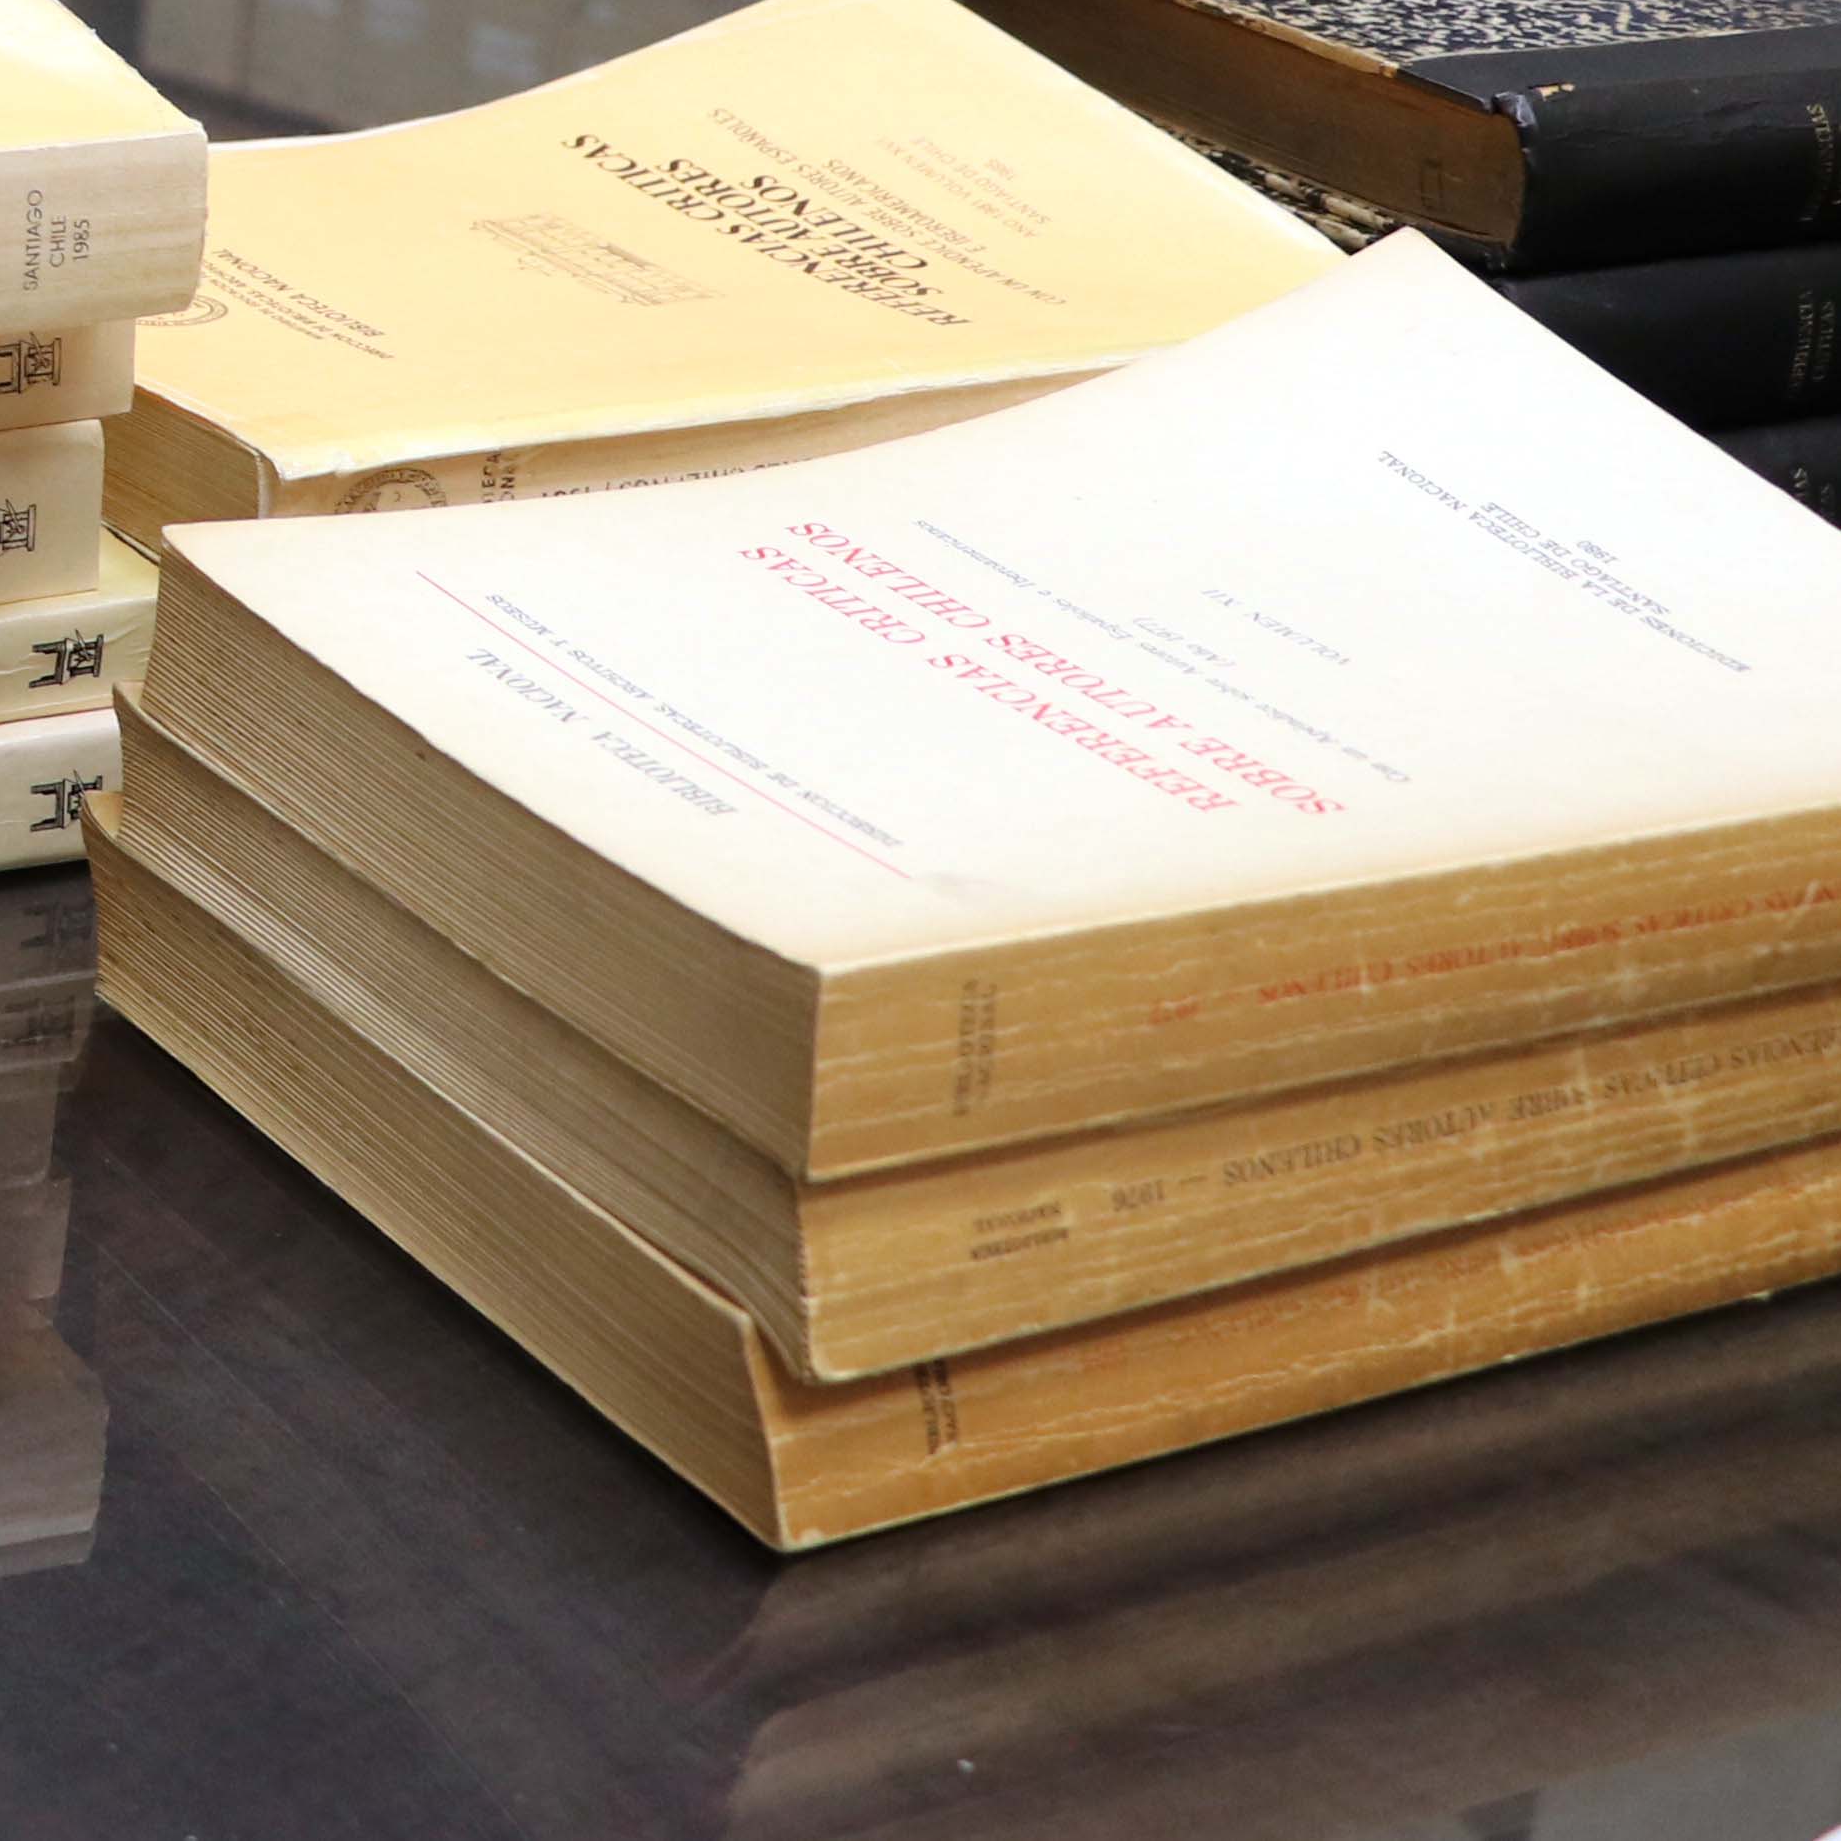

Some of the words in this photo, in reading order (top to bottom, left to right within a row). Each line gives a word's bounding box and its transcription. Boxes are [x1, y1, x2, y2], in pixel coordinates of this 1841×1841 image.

[561, 133, 725, 222] CRITICAS
[656, 158, 826, 242] AUTORES
[795, 163, 867, 206] AUTORES
[823, 159, 972, 245] IBEROAMERICANOS
[24, 189, 44, 291] SANTIAGO
[50, 214, 67, 268] CHILE
[73, 217, 91, 260] 1985
[741, 174, 928, 271] CHILENOS
[865, 208, 923, 239] SOBRE
[214, 249, 293, 291] NACIONAL
[717, 223, 974, 326] REFERENCIAS
[810, 243, 943, 296] SOBRE
[917, 238, 1001, 278] APENDICE
[291, 293, 385, 337] BIBLIOTECA
[1377, 450, 1467, 511] NACIONAL
[1468, 511, 1579, 581] BIBLIOTECA
[1480, 501, 1541, 539] CHILE
[1539, 539, 1572, 558] DE
[786, 520, 990, 630] CHILENOS
[1576, 539, 1619, 565] 1980
[735, 544, 926, 646] CRITICAS
[1570, 558, 1670, 615] SANTIAGO
[1580, 580, 1609, 597] LA
[1607, 597, 1642, 615] DE
[1247, 610, 1352, 665] VOLUMEN
[1640, 615, 1752, 673] EDICIONES
[466, 647, 589, 723] NACIONAL
[984, 632, 1193, 733] AUTORES
[926, 652, 1242, 814] REFERENCIAS
[591, 730, 740, 816] BIBLIOTECA
[1176, 735, 1347, 817] SOBRE
